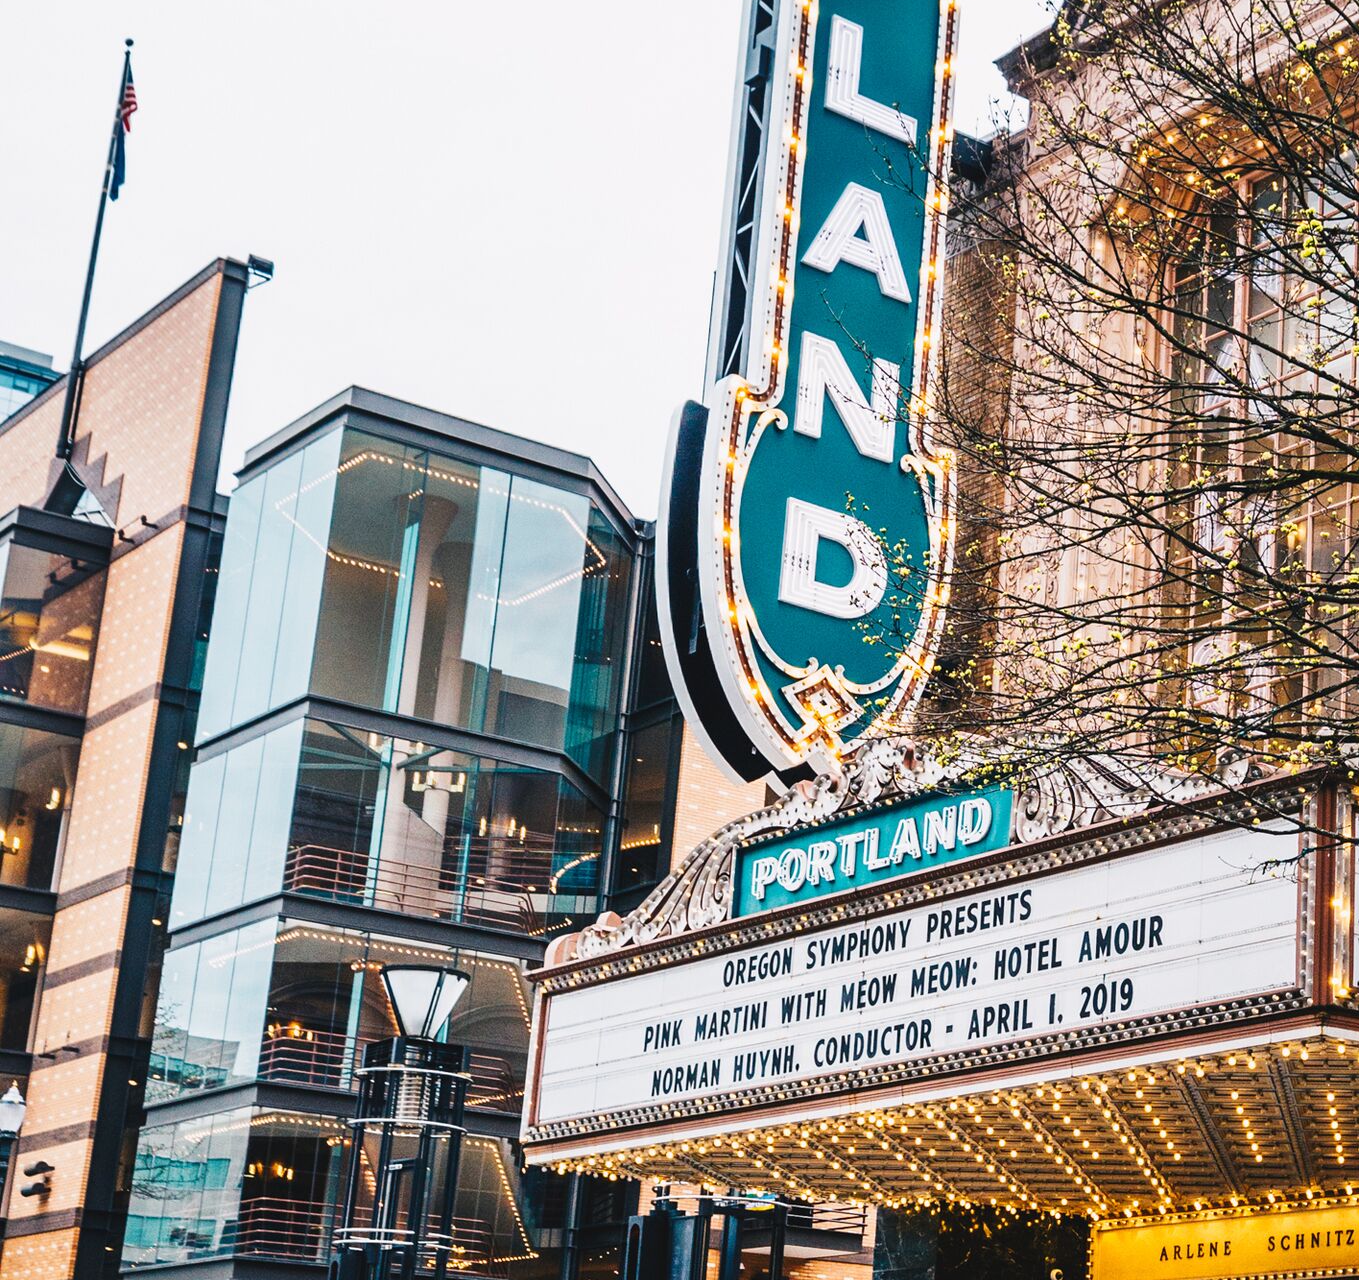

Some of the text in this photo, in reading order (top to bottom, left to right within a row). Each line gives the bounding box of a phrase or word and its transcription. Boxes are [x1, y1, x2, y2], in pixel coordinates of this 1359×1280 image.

[750, 796, 993, 900] PORTLAND
[643, 915, 1164, 1053] PINK MARTINI WITH MEOW MEOW: HOTEL AMOUR
[723, 889, 1033, 987] OREGON SYMPHONY PRESENTS
[651, 1058, 721, 1097] NORMAN
[814, 1018, 932, 1067] CONDUCTOR
[967, 998, 1033, 1040] APRIL
[1079, 977, 1134, 1019] 2019
[1159, 1240, 1232, 1262] ARLENE
